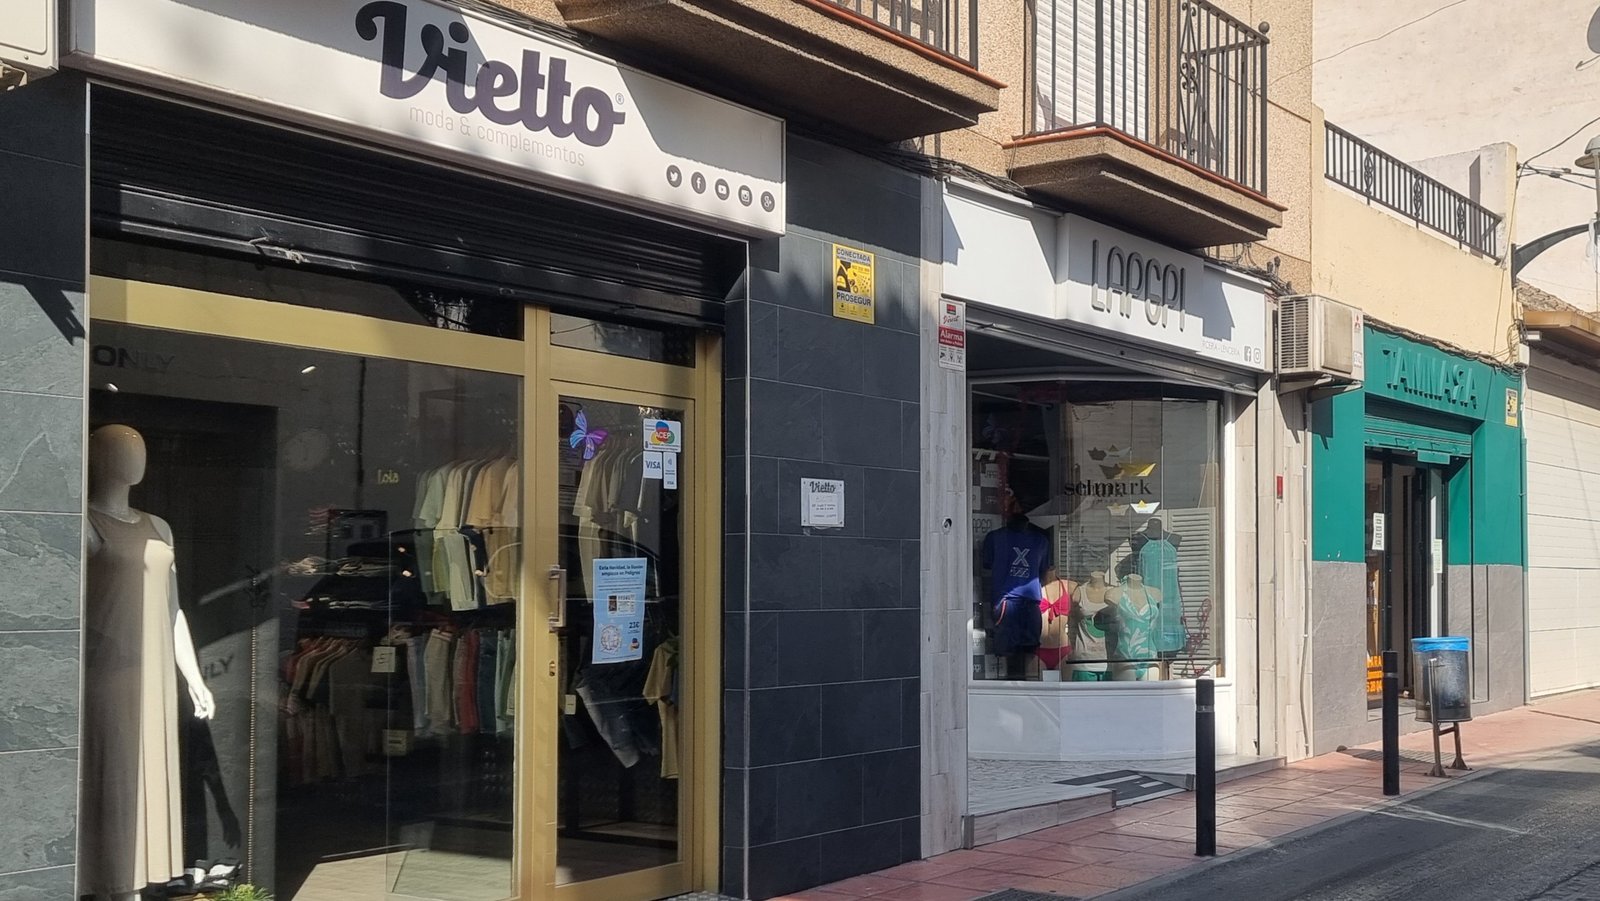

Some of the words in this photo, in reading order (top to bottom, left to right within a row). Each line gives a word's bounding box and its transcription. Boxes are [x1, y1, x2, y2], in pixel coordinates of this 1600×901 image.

[355, 0, 626, 147] Vietto
[409, 105, 454, 131] moda
[459, 116, 471, 136] &
[477, 124, 585, 167] complementos
[836, 248, 871, 263] CONECTADA
[836, 291, 871, 307] PROSEGUR
[940, 329, 963, 342] Alarma
[645, 460, 661, 469] VISA
[810, 481, 836, 493] Vietto
